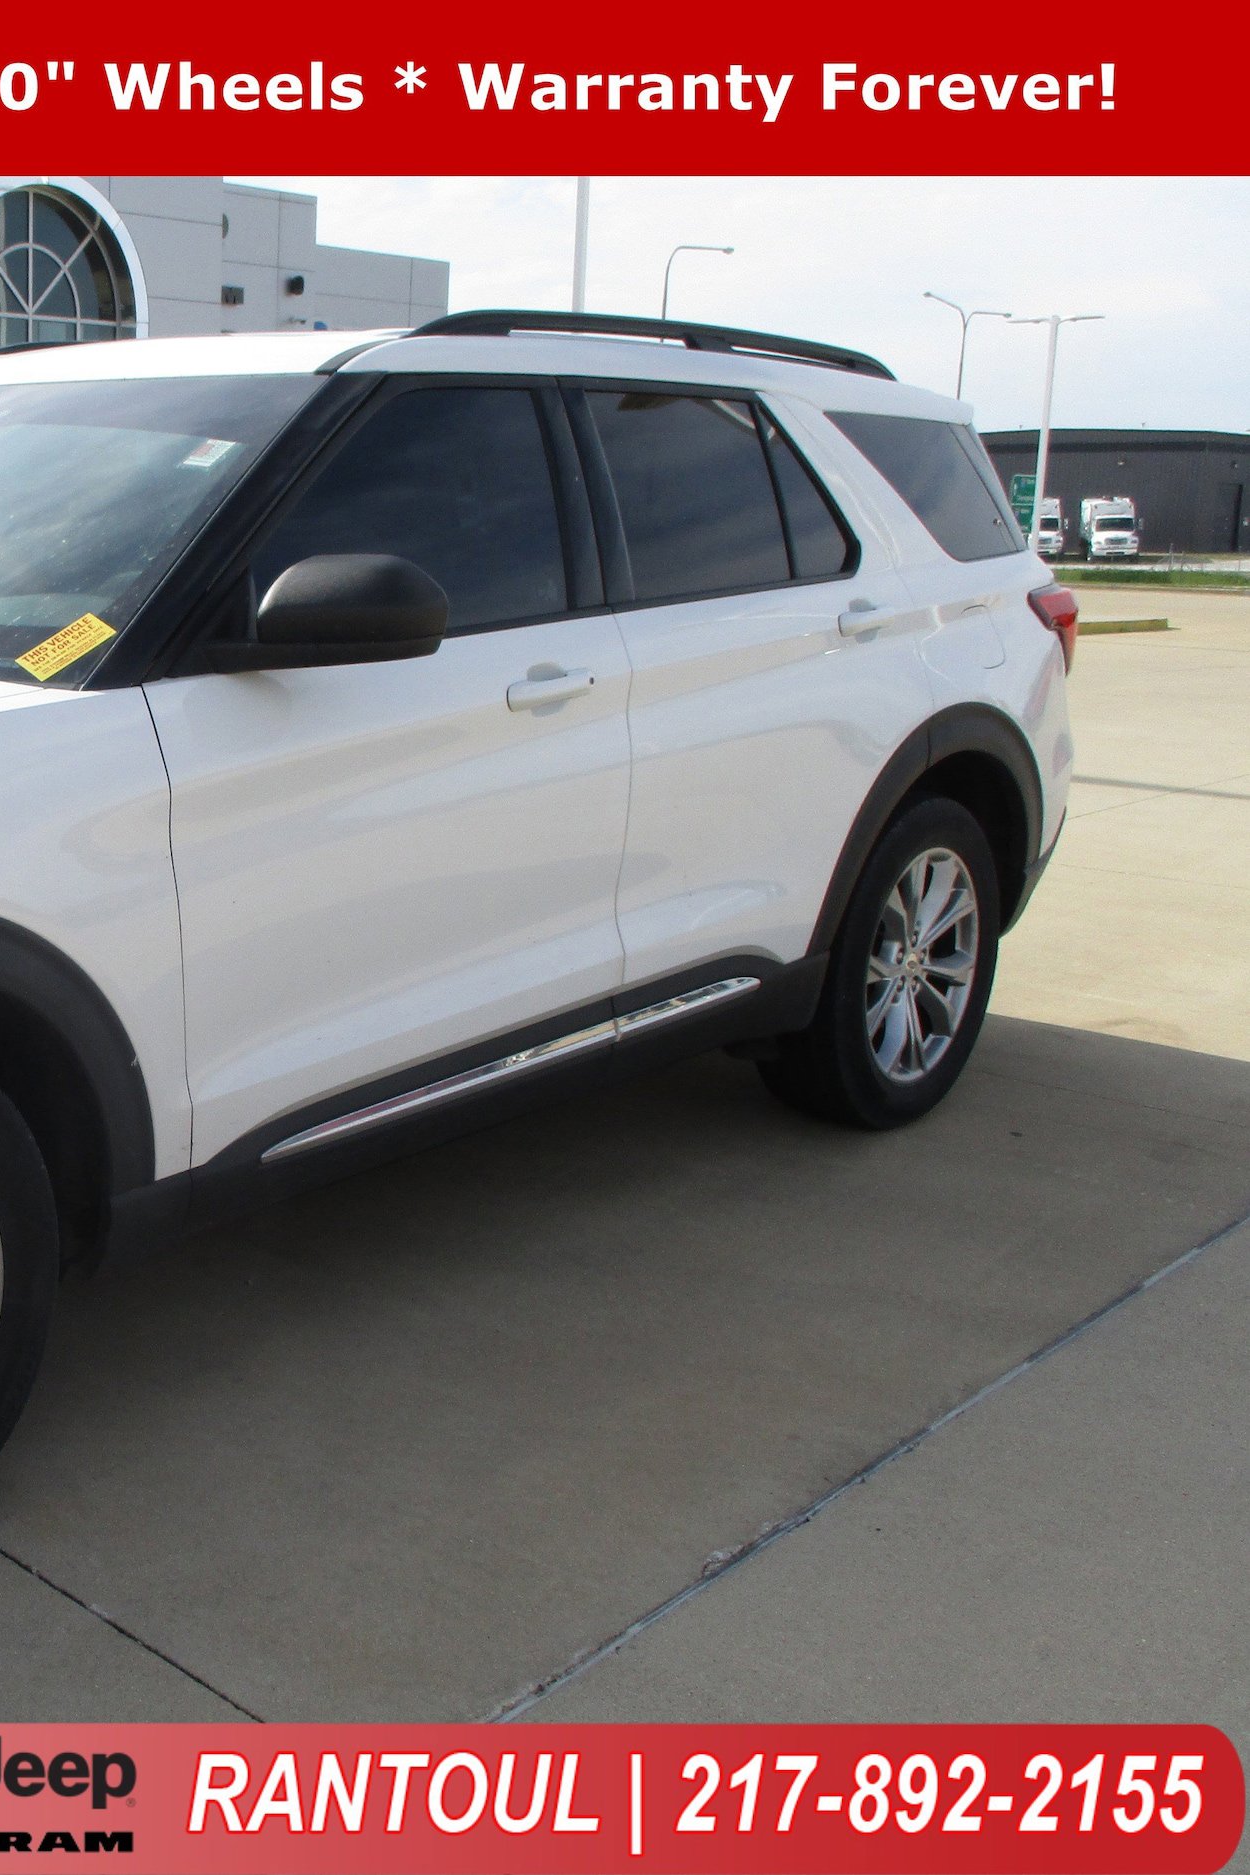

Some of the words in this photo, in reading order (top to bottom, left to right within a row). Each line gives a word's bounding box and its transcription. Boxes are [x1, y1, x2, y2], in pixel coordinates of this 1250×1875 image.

[21, 645, 48, 663] THIS
[47, 618, 91, 646] VEHICLE
[31, 652, 51, 667] NOT
[51, 640, 71, 654] FOR
[71, 624, 94, 641] SALE
